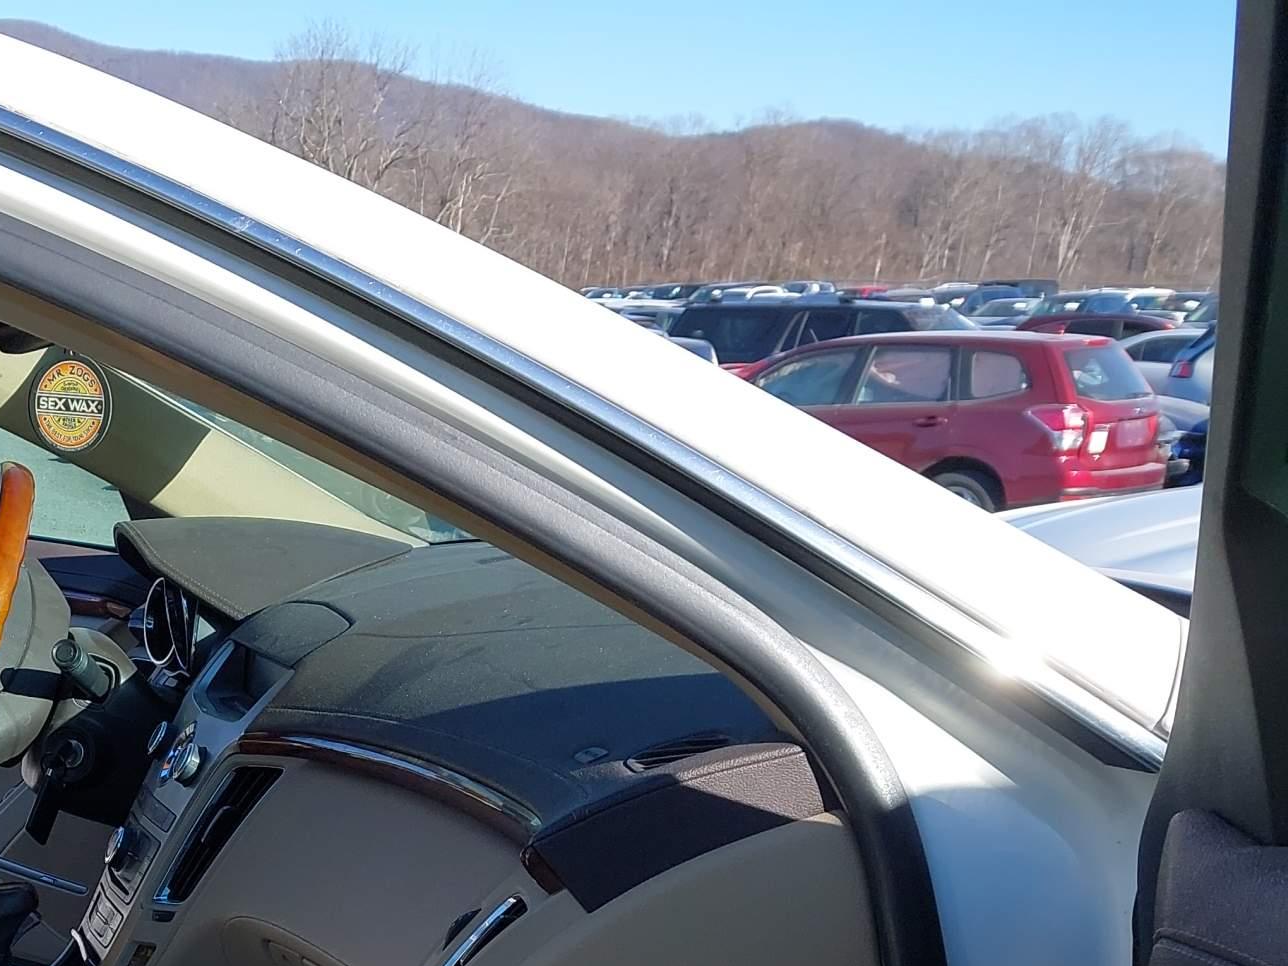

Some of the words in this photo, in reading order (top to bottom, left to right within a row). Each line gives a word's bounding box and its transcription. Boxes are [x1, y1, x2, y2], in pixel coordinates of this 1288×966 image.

[69, 365, 96, 388] ZOGS
[39, 396, 66, 410] SEX
[68, 399, 98, 413] WAX
